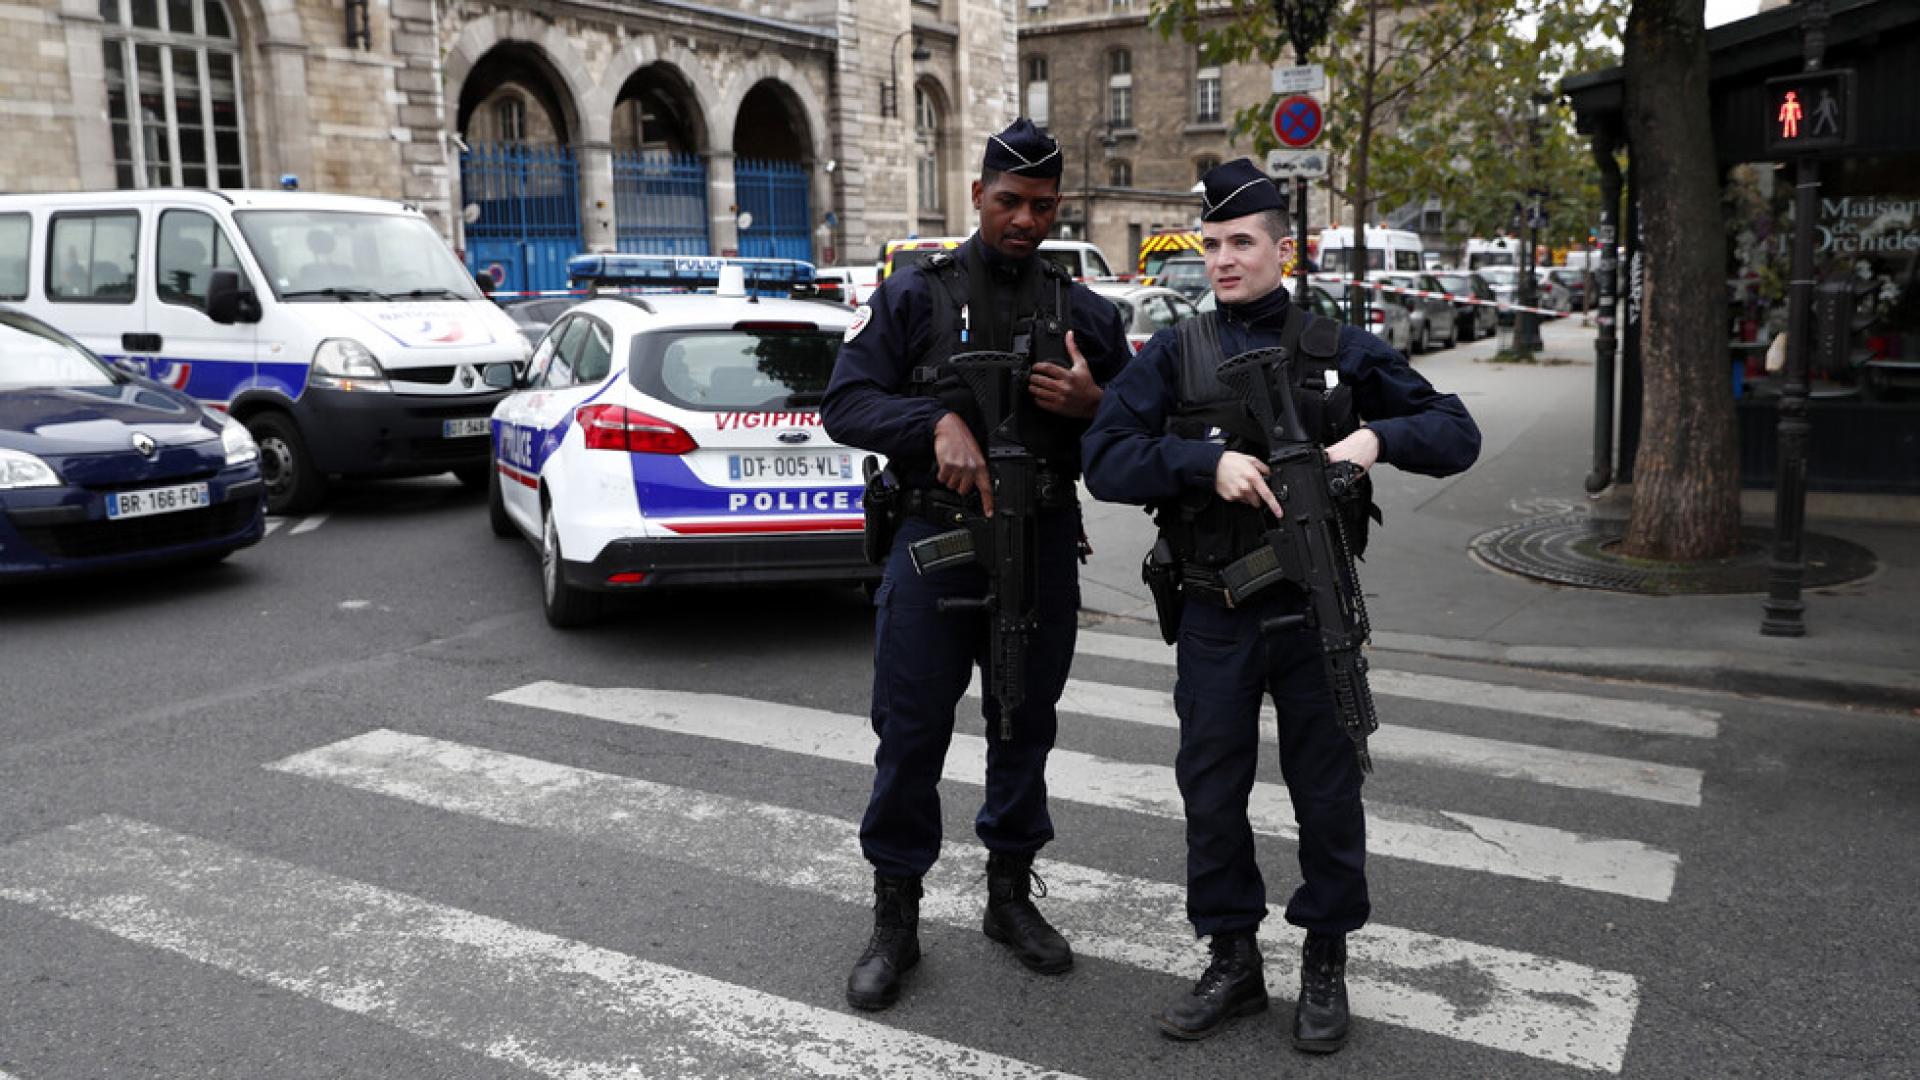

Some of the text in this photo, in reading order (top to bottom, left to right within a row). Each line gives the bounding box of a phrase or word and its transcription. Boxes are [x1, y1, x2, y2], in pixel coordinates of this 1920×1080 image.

[1821, 196, 1920, 218] Maison
[715, 411, 823, 431] VIGIPIR
[728, 491, 850, 512] POLICE
